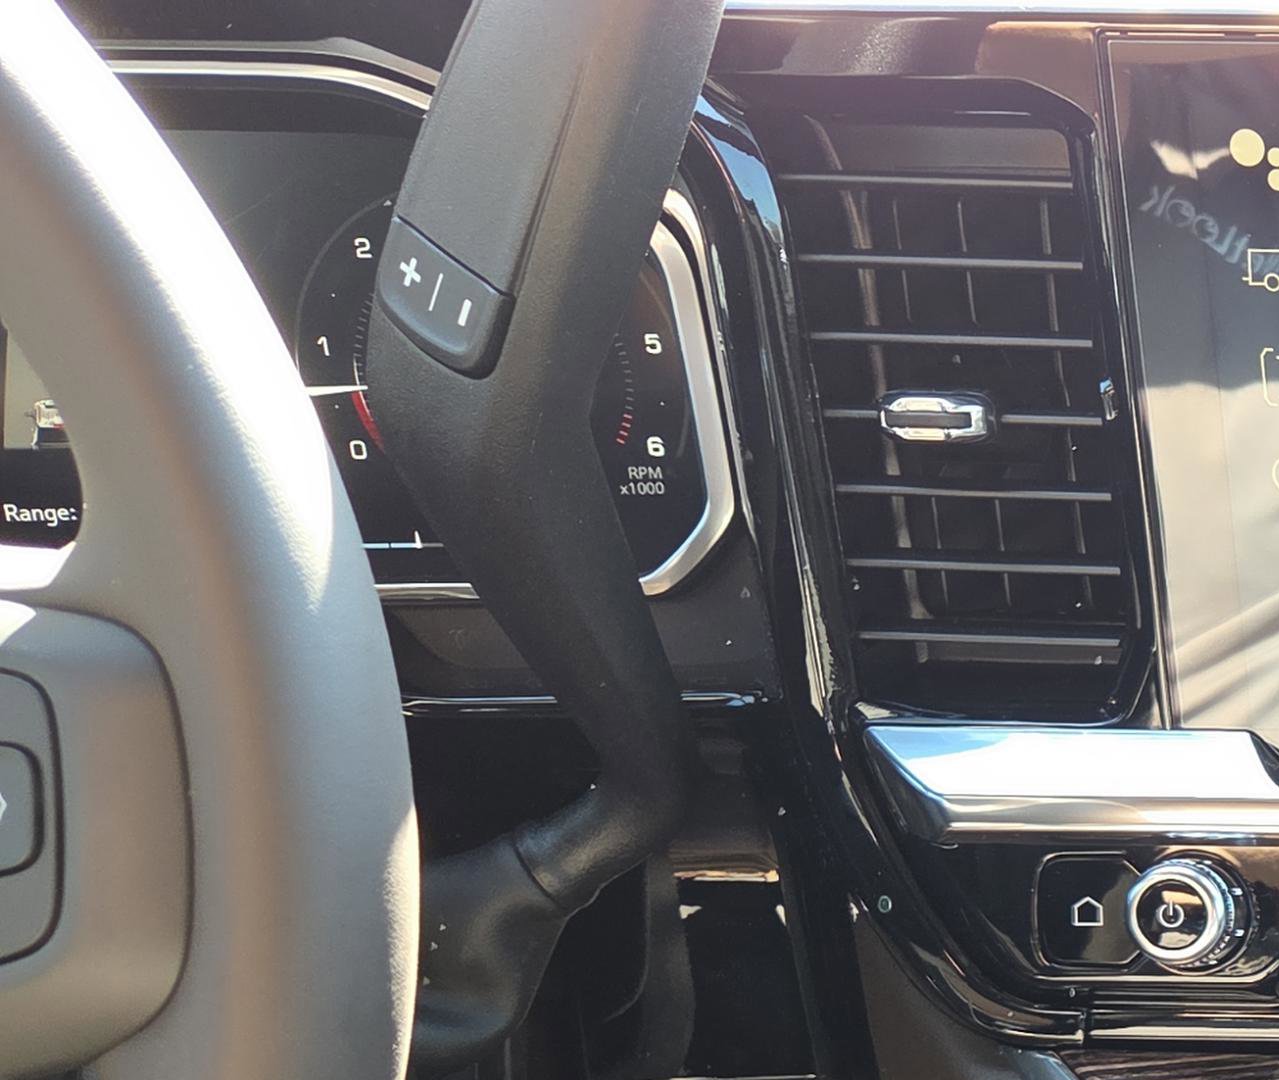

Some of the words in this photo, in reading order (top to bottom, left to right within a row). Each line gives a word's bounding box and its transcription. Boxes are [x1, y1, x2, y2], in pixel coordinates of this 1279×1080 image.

[353, 236, 373, 259] 2
[316, 335, 331, 357] 1
[643, 333, 663, 355] 5
[349, 439, 368, 461] 0
[646, 436, 666, 458] 6
[627, 466, 663, 480] RPM
[620, 481, 665, 495] x1000
[2, 503, 78, 527] Range:
